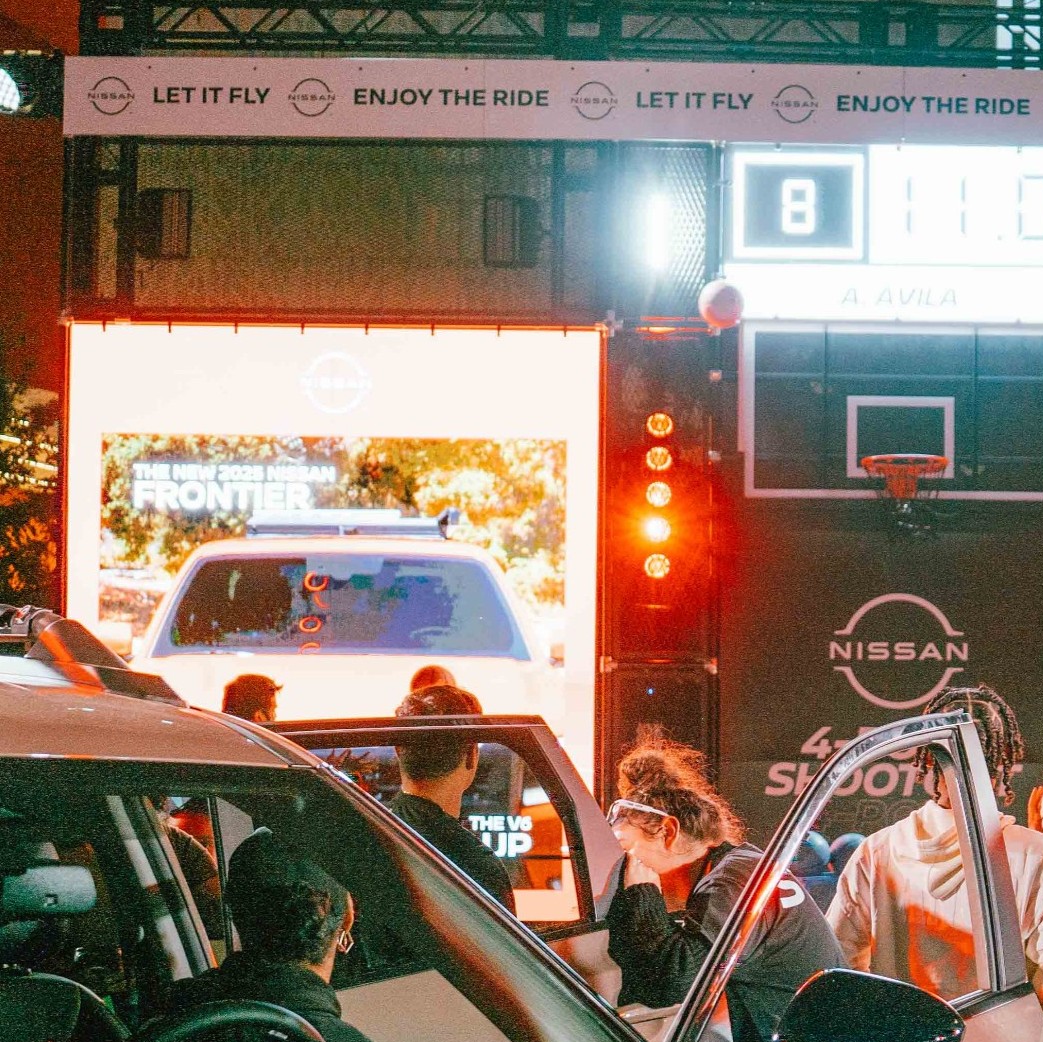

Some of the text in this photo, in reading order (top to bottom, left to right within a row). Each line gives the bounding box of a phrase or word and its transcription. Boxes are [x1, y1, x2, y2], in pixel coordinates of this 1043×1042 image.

[87, 92, 136, 100] NISSAN
[153, 86, 196, 104] LET
[202, 87, 223, 104] IT
[229, 87, 270, 104] FLY
[287, 93, 336, 101] NISSAN
[353, 88, 434, 106] ENJOY
[438, 89, 487, 106] THE
[493, 89, 549, 107] RIDE
[570, 97, 619, 105] NISSAN
[636, 91, 679, 109] LET
[684, 92, 706, 109] IT
[712, 92, 754, 110] FLY
[836, 94, 917, 113] ENJOY
[921, 96, 968, 114] THE
[975, 97, 1030, 115] RIDE
[781, 178, 816, 235] 8
[874, 288, 958, 307] AVILA
[133, 463, 170, 480] THE
[172, 464, 217, 480] NEW
[267, 465, 336, 482] NISSAN
[133, 480, 311, 510] FRONTIER
[829, 640, 969, 661] NISSAN
[468, 815, 533, 831] THE V6
[481, 832, 533, 857] UP
